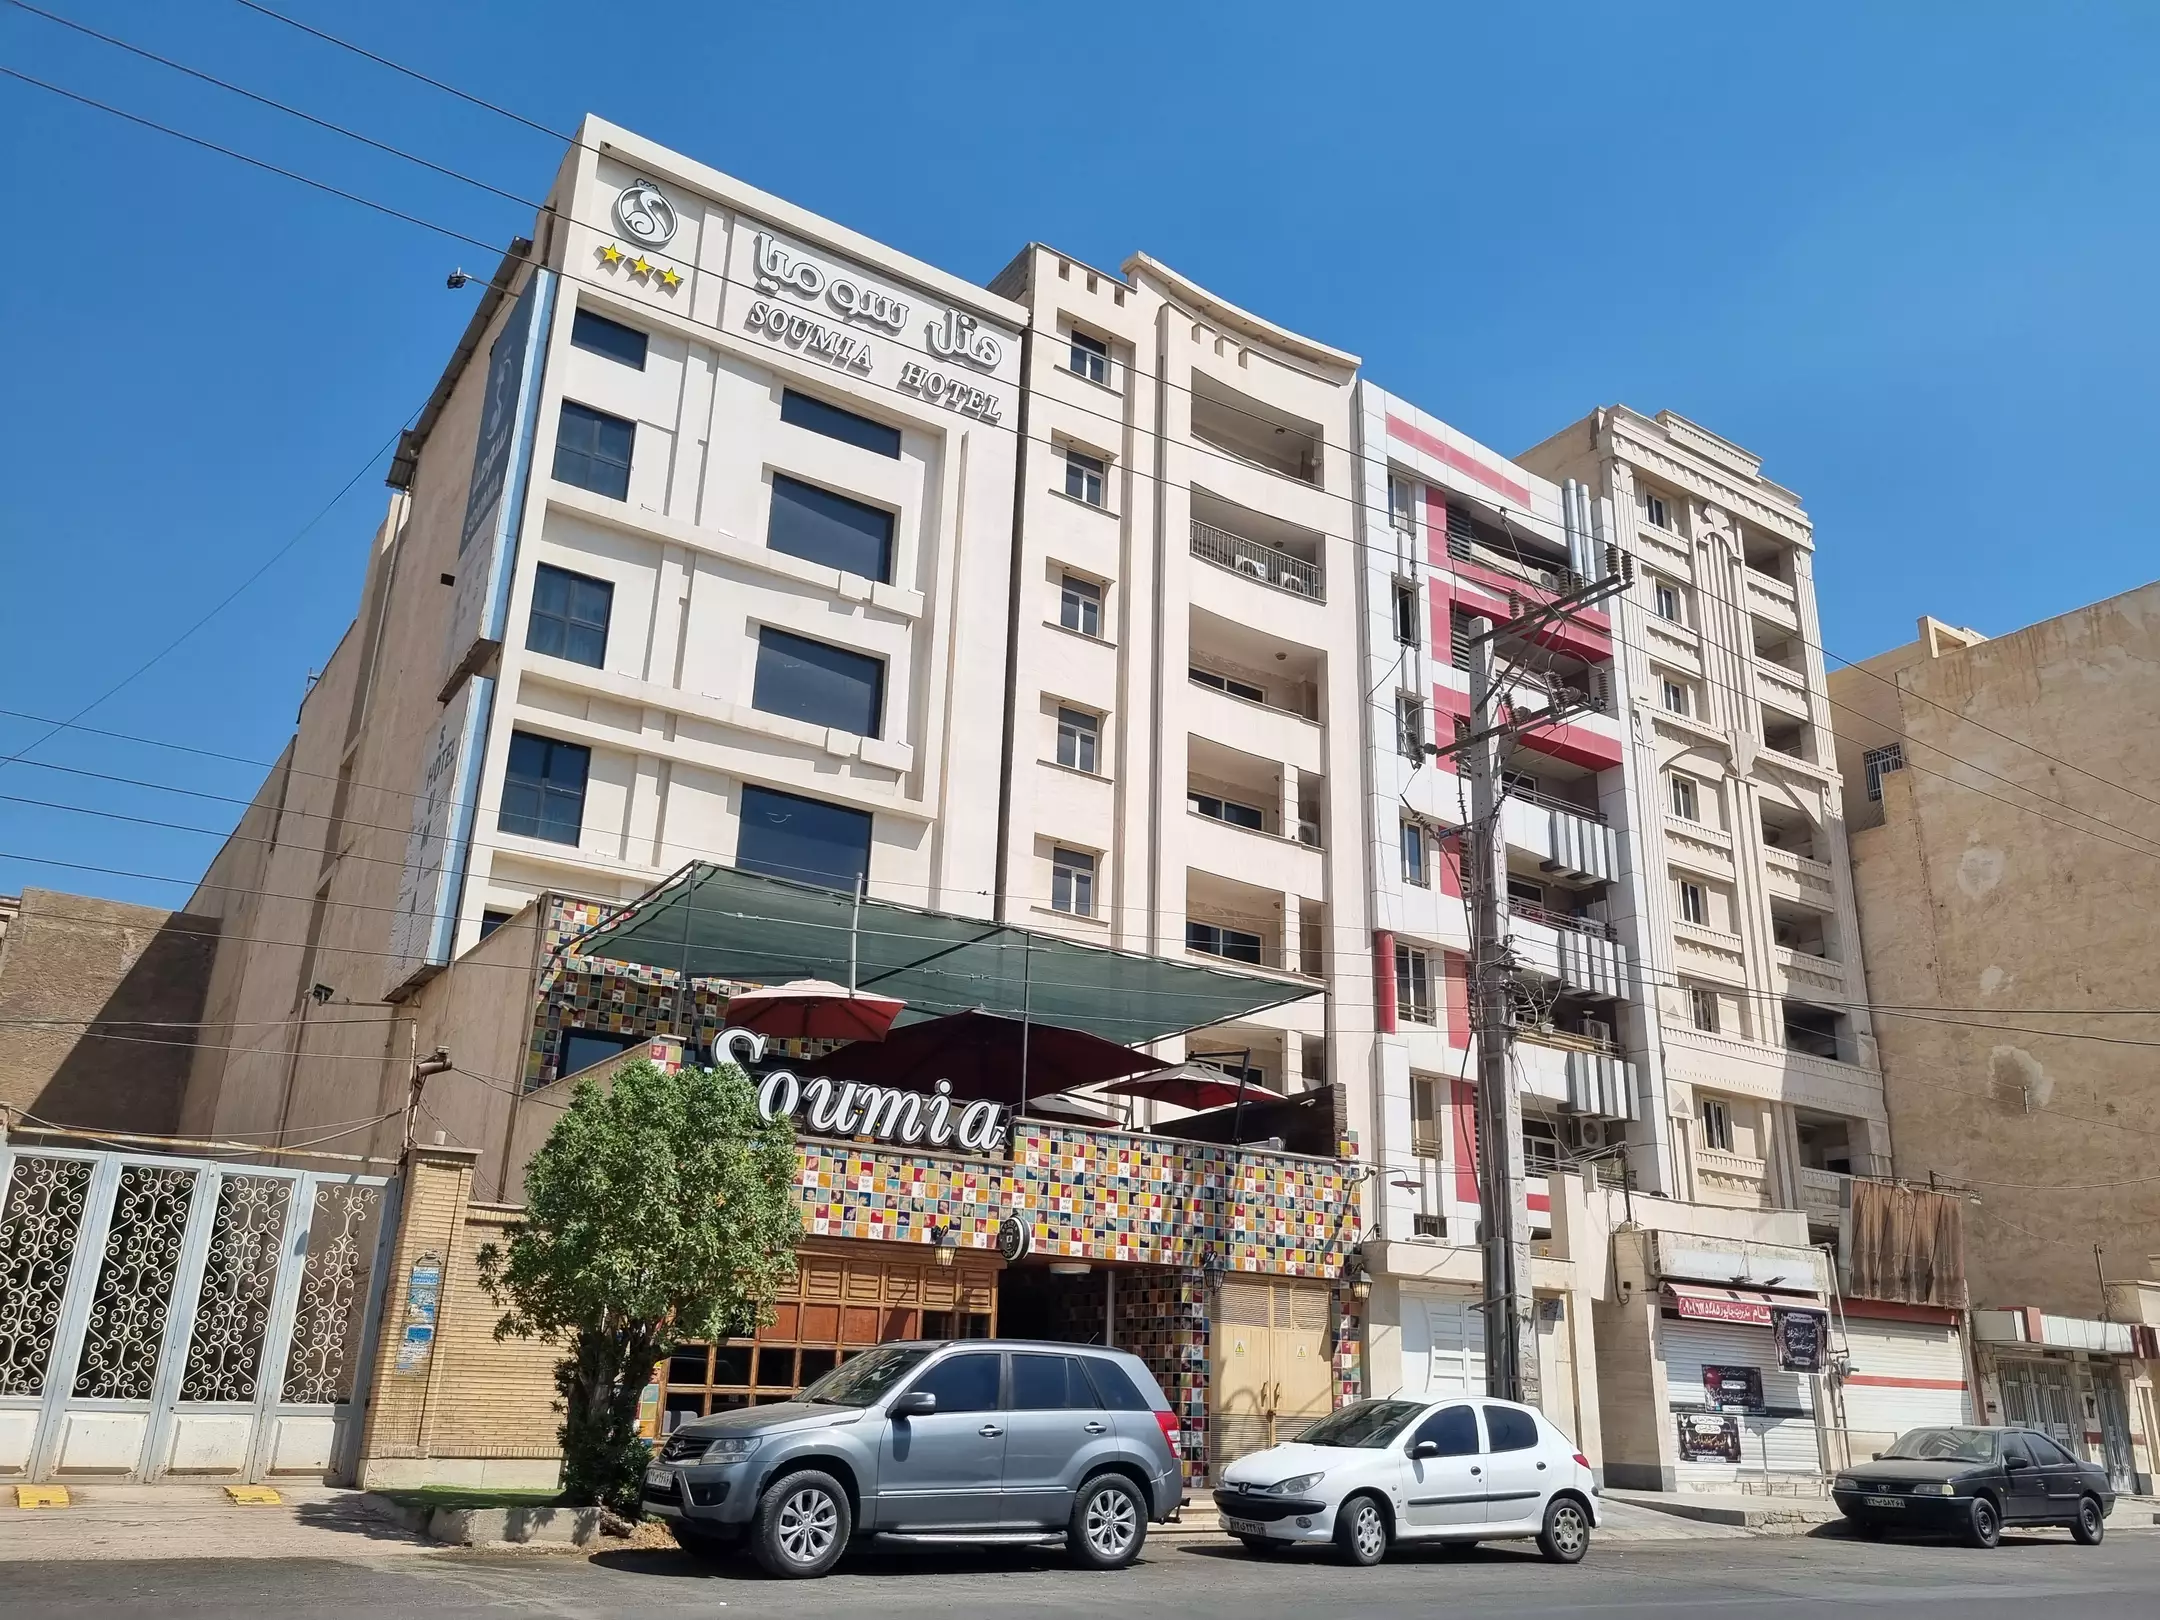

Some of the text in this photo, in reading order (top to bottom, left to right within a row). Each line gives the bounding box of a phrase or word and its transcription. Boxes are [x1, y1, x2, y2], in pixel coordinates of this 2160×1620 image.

[748, 300, 1002, 421] SOUMIA HOTEL
[758, 230, 1003, 367] هتل سومیا
